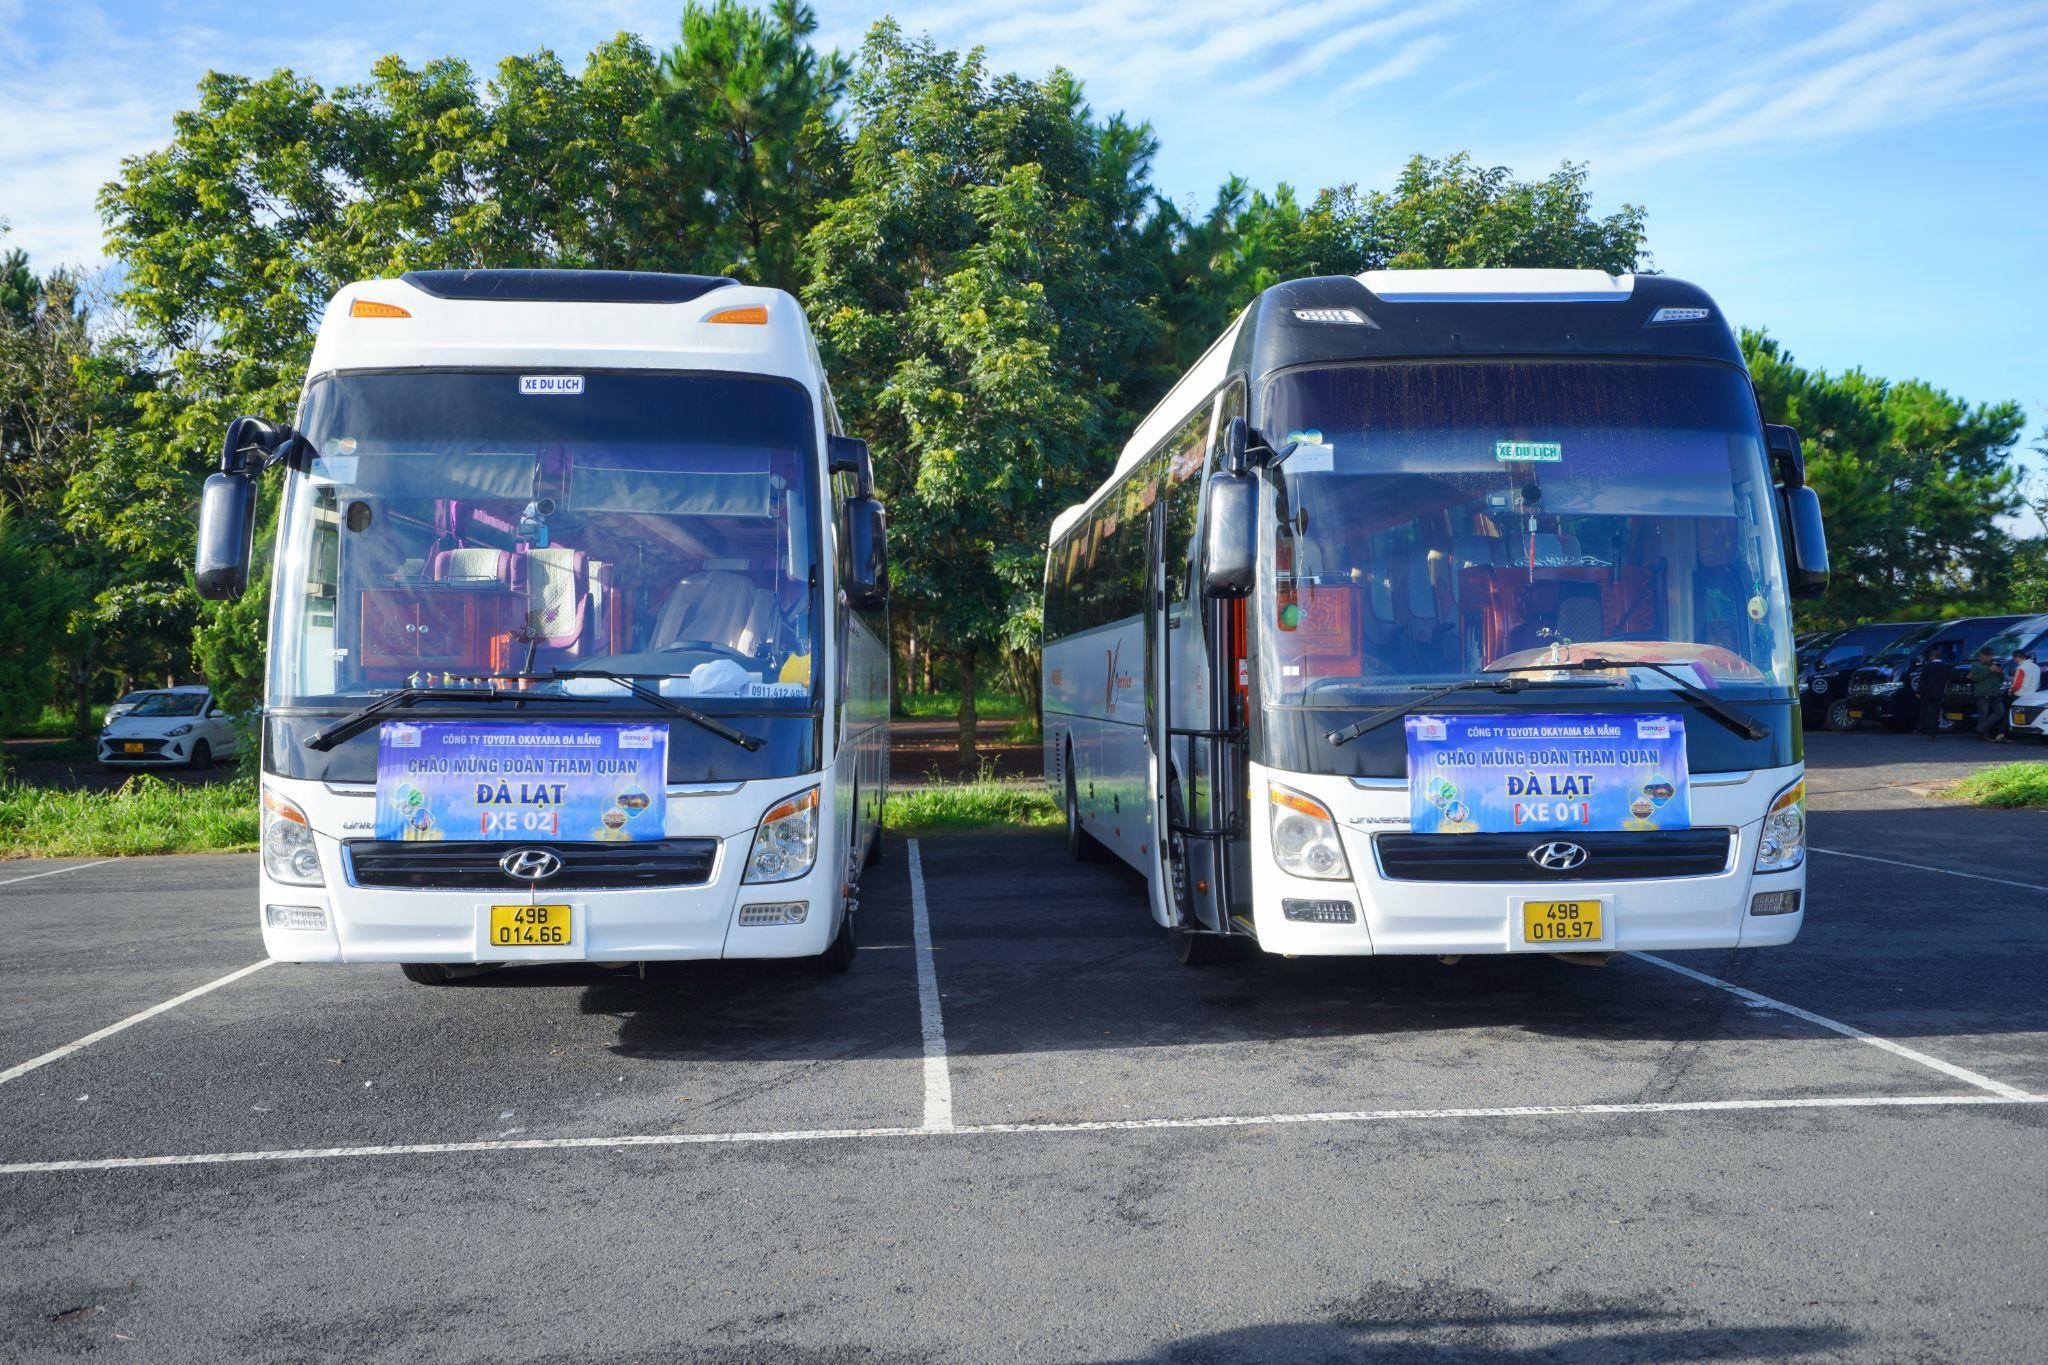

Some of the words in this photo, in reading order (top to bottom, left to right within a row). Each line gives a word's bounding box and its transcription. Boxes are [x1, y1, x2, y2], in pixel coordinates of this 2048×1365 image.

[525, 379, 537, 389] XE
[540, 379, 554, 389] DU
[557, 379, 579, 392] LỊCH
[1500, 446, 1512, 456] XE
[1516, 446, 1530, 456] DU
[442, 733, 467, 745] CÔNG
[469, 735, 480, 745] TY
[483, 735, 516, 745] TOYOTA
[518, 735, 560, 745] OKAYAMA
[562, 733, 578, 745] ĐÀ
[1467, 726, 1491, 737] CÔNG
[1493, 727, 1504, 737] TY
[1507, 727, 1539, 737] TOYOTA
[1541, 727, 1582, 737] OKAYAMA
[1583, 725, 1598, 737] ĐÀ
[1436, 747, 1476, 765] CHÀO
[1481, 747, 1525, 765] MỪNG
[1529, 746, 1569, 765] ĐOÀN
[1574, 750, 1615, 764] THAM
[1620, 750, 1659, 765] QUAN
[408, 755, 449, 774] CHÀO
[453, 755, 498, 774] MỪNG
[503, 755, 544, 774] ĐOÀN
[548, 759, 592, 774] THAM
[597, 759, 638, 775] QUAN
[475, 779, 512, 804] ĐÀ
[520, 783, 567, 808] LẠT
[1507, 771, 1543, 796] ĐÀ
[1550, 775, 1593, 800] LẠT
[1514, 802, 1550, 825] [XE
[1555, 802, 1589, 825] 01]
[481, 811, 518, 834] [XE
[523, 811, 558, 836] 02]
[514, 907, 548, 924] 49B
[1546, 903, 1579, 920] 49B
[500, 926, 562, 943] 014.66
[1533, 921, 1593, 939] 018.97
